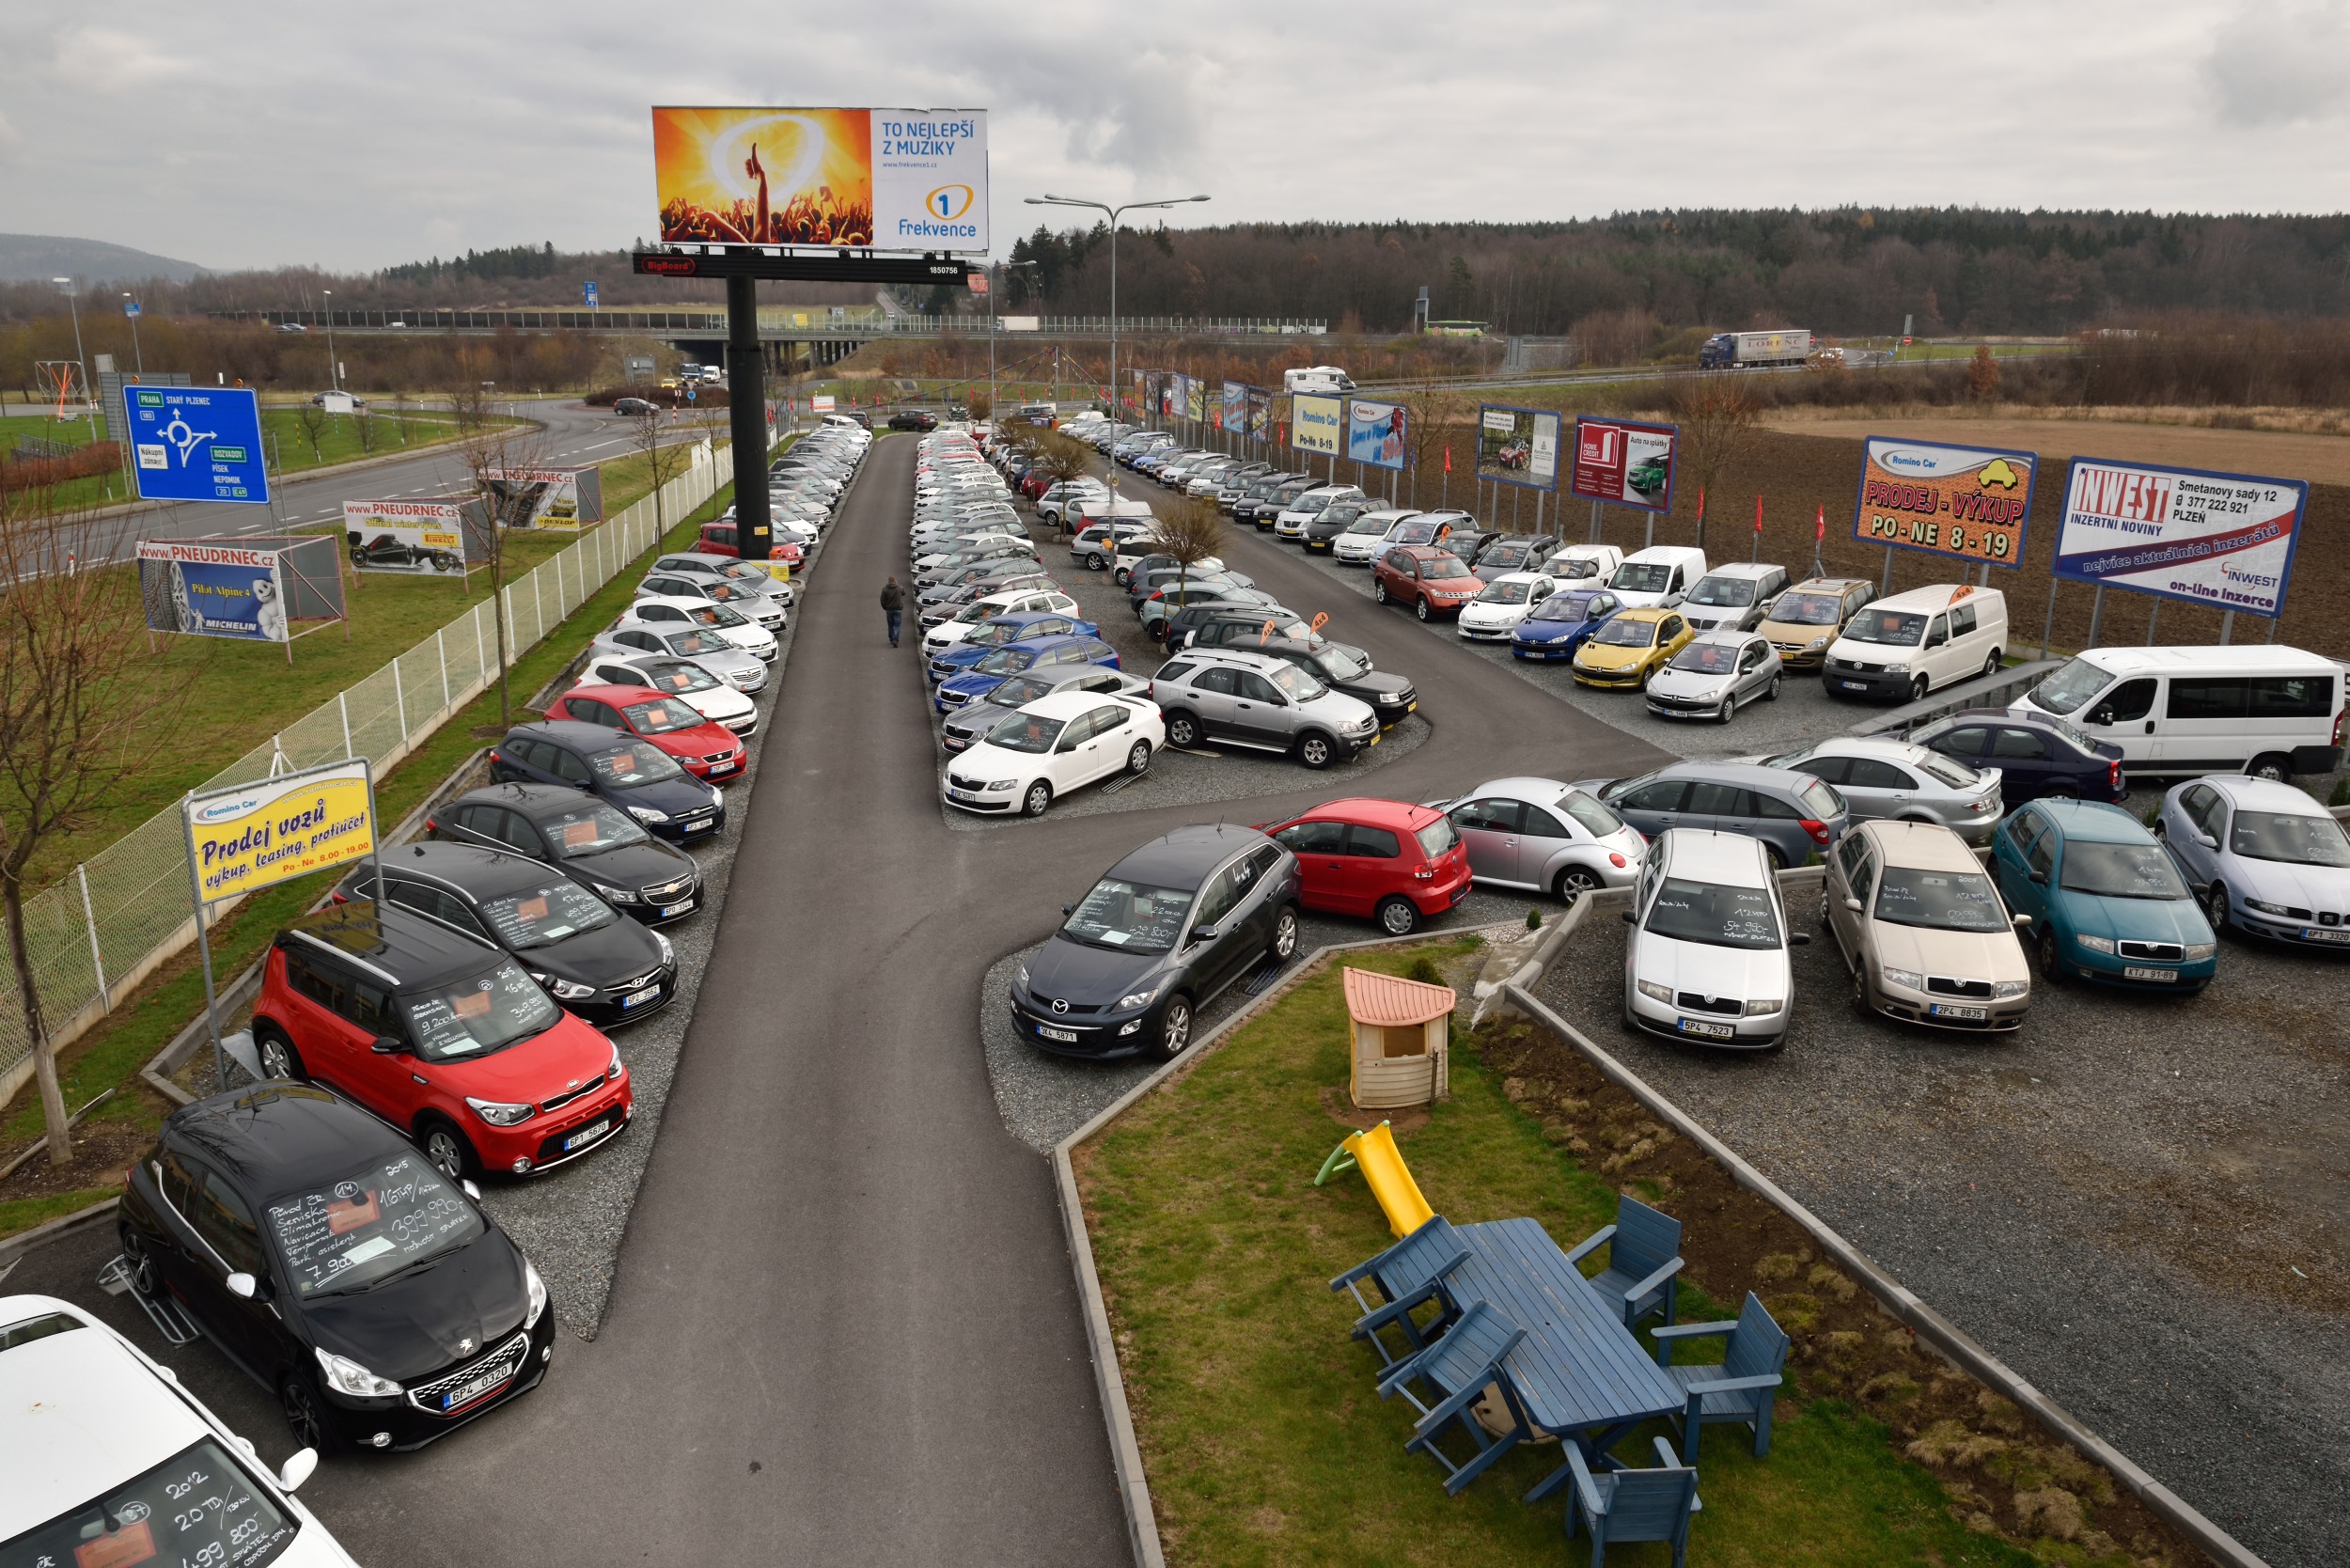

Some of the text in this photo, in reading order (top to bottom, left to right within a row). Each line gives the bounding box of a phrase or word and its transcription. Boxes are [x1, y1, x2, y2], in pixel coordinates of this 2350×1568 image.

[882, 119, 975, 140] TO NEJLEPŠÍ
[883, 140, 955, 156] Z MUZIKY
[938, 194, 948, 216] 1
[899, 219, 977, 238] Frekvence
[648, 261, 689, 272] BigBoard
[929, 266, 959, 274] 1850756
[1747, 338, 1801, 348] LORENC
[140, 395, 161, 404] PRAHA
[165, 395, 211, 405] STARÝ PLZENEC
[1302, 410, 1339, 427] Romino Car
[1583, 443, 1597, 451] HOME
[1630, 436, 1642, 445] Auto
[1650, 438, 1668, 448] splátky
[213, 449, 243, 459] ROZVADOV
[1582, 449, 1599, 458] CREDIT
[1892, 455, 1936, 468] Romino Car
[212, 463, 229, 473] PÍSEK
[212, 475, 242, 484] NEPOMUK
[2178, 479, 2277, 503] Smetanovy sady 12
[346, 503, 457, 518] www.PNEUDRNEC.cz
[1865, 480, 1939, 514] PRODEJ
[1952, 490, 2025, 525] VÝKUP
[2187, 495, 2248, 514] 377 222 921
[365, 518, 442, 531] Official winter tyres
[2070, 512, 2163, 537] INZERTNÍ NOVINY
[2172, 509, 2206, 524] PLZEŇ
[424, 534, 455, 544] PIRELLI
[1871, 514, 1898, 538] PO
[1910, 521, 1939, 545] NE
[1950, 526, 1965, 550] 8
[1982, 531, 2010, 557] 19
[138, 545, 274, 567] www.PNEUDRNEC.cz
[2083, 522, 2280, 575] nejvíce aktuálních inzerátů
[2228, 570, 2279, 588] INWEST
[191, 583, 251, 599] Pilot Alpine 4
[1956, 587, 1971, 599] 4x4
[2170, 579, 2218, 599] on-line
[205, 619, 258, 631] MICHELIN
[1314, 614, 1326, 627] 4x4
[1211, 670, 1228, 682] 4x4
[282, 780, 358, 804] www.rominocar.cz
[206, 799, 258, 818] Romino Car
[201, 798, 325, 868] Prodej vozů
[205, 811, 366, 889] výkup, leasing, protiúčet
[282, 863, 295, 873] Po
[302, 858, 315, 868] Ne
[320, 850, 339, 862] 8.00
[345, 841, 369, 855] 19.00
[1232, 862, 1251, 885] 4x4
[2308, 930, 2350, 941] 6P1 3320
[2127, 966, 2144, 977] KTJ
[628, 986, 658, 1005] 6P2 3562
[1937, 1005, 1983, 1019] 2P4 8835
[431, 1016, 450, 1028] 200
[1684, 1021, 1701, 1031] 5P4
[1707, 1025, 1730, 1036] 7523
[1041, 1026, 1074, 1041] 3K4 5871
[570, 1123, 607, 1147] 6P1 5670
[385, 1159, 409, 1176] 2015
[280, 1211, 343, 1237] Climatronic
[391, 1209, 429, 1242] 399
[305, 1264, 322, 1280] 7
[452, 1364, 509, 1403] 6P4 0320
[165, 1471, 209, 1500] 2012
